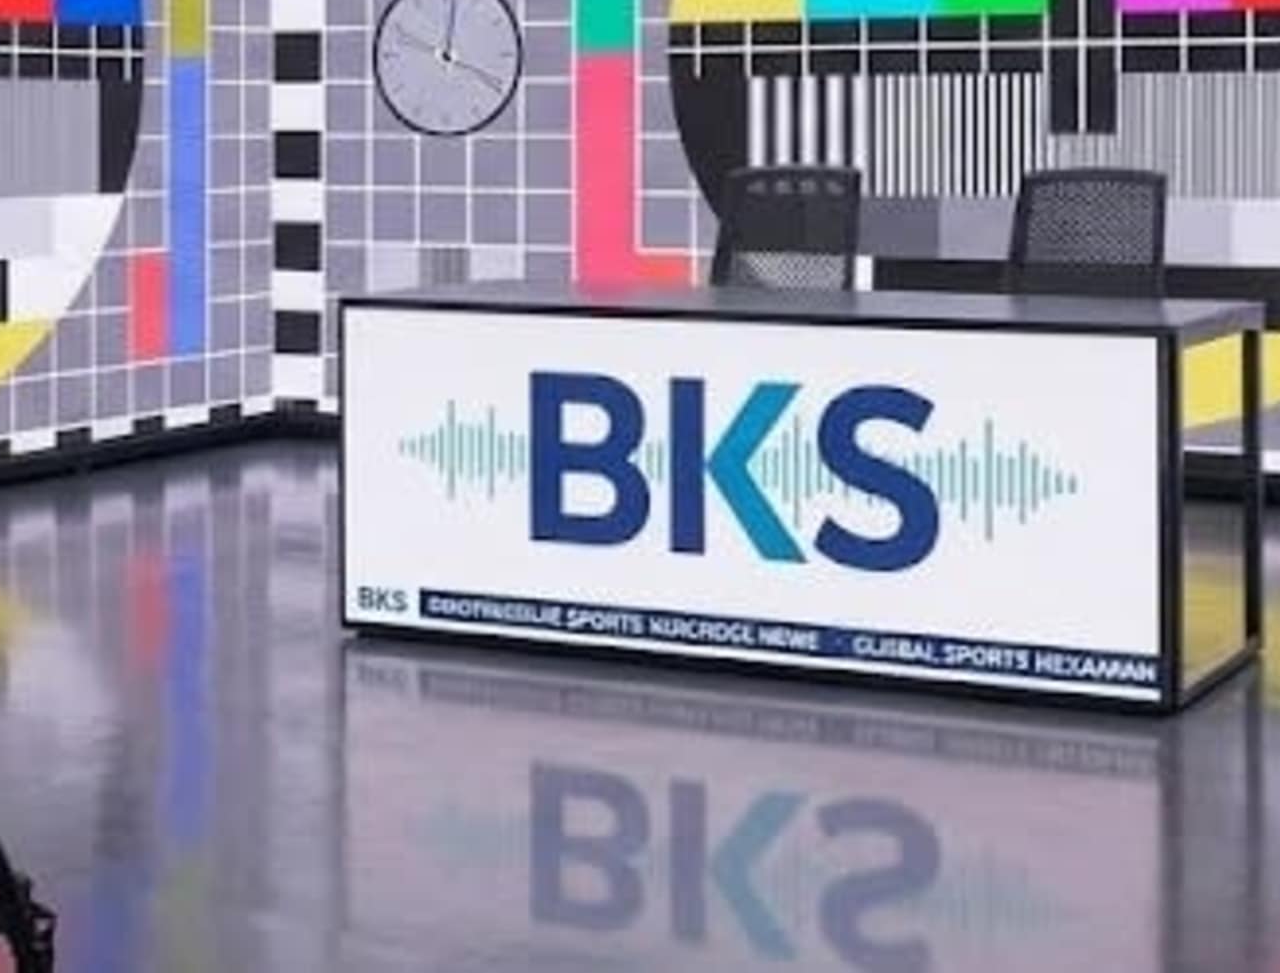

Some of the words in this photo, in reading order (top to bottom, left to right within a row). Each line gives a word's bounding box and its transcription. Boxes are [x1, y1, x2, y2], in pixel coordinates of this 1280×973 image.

[528, 370, 942, 573] BKS
[357, 586, 408, 613] BKS
[943, 642, 1030, 671] SPORTS
